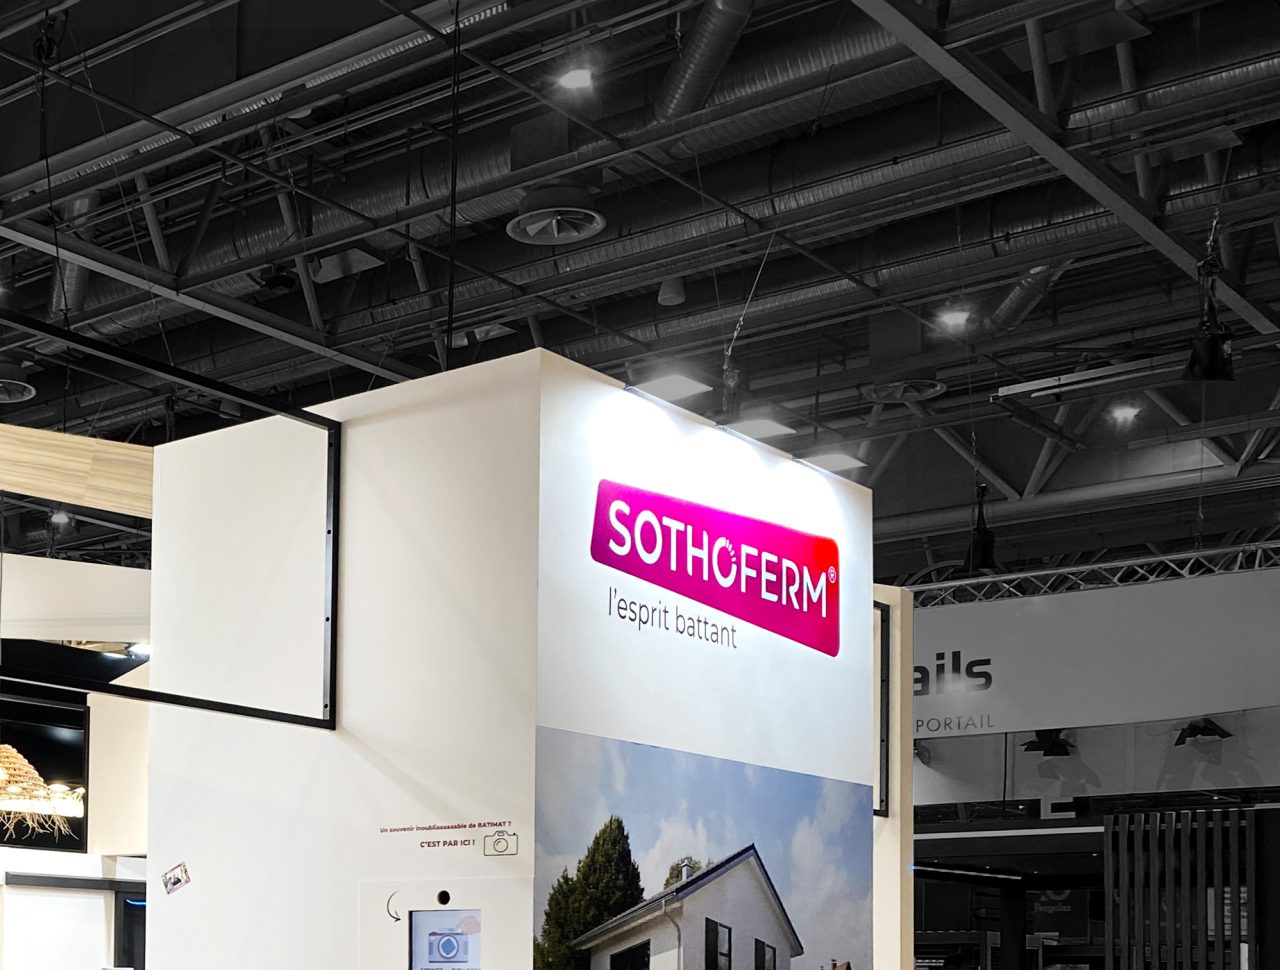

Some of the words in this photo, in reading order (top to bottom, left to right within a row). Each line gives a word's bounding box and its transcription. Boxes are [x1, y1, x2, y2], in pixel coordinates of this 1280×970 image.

[608, 586, 669, 631] l'esprit
[675, 605, 738, 649] battant
[916, 714, 995, 733] PORTAIL
[389, 825, 415, 833] souvenir
